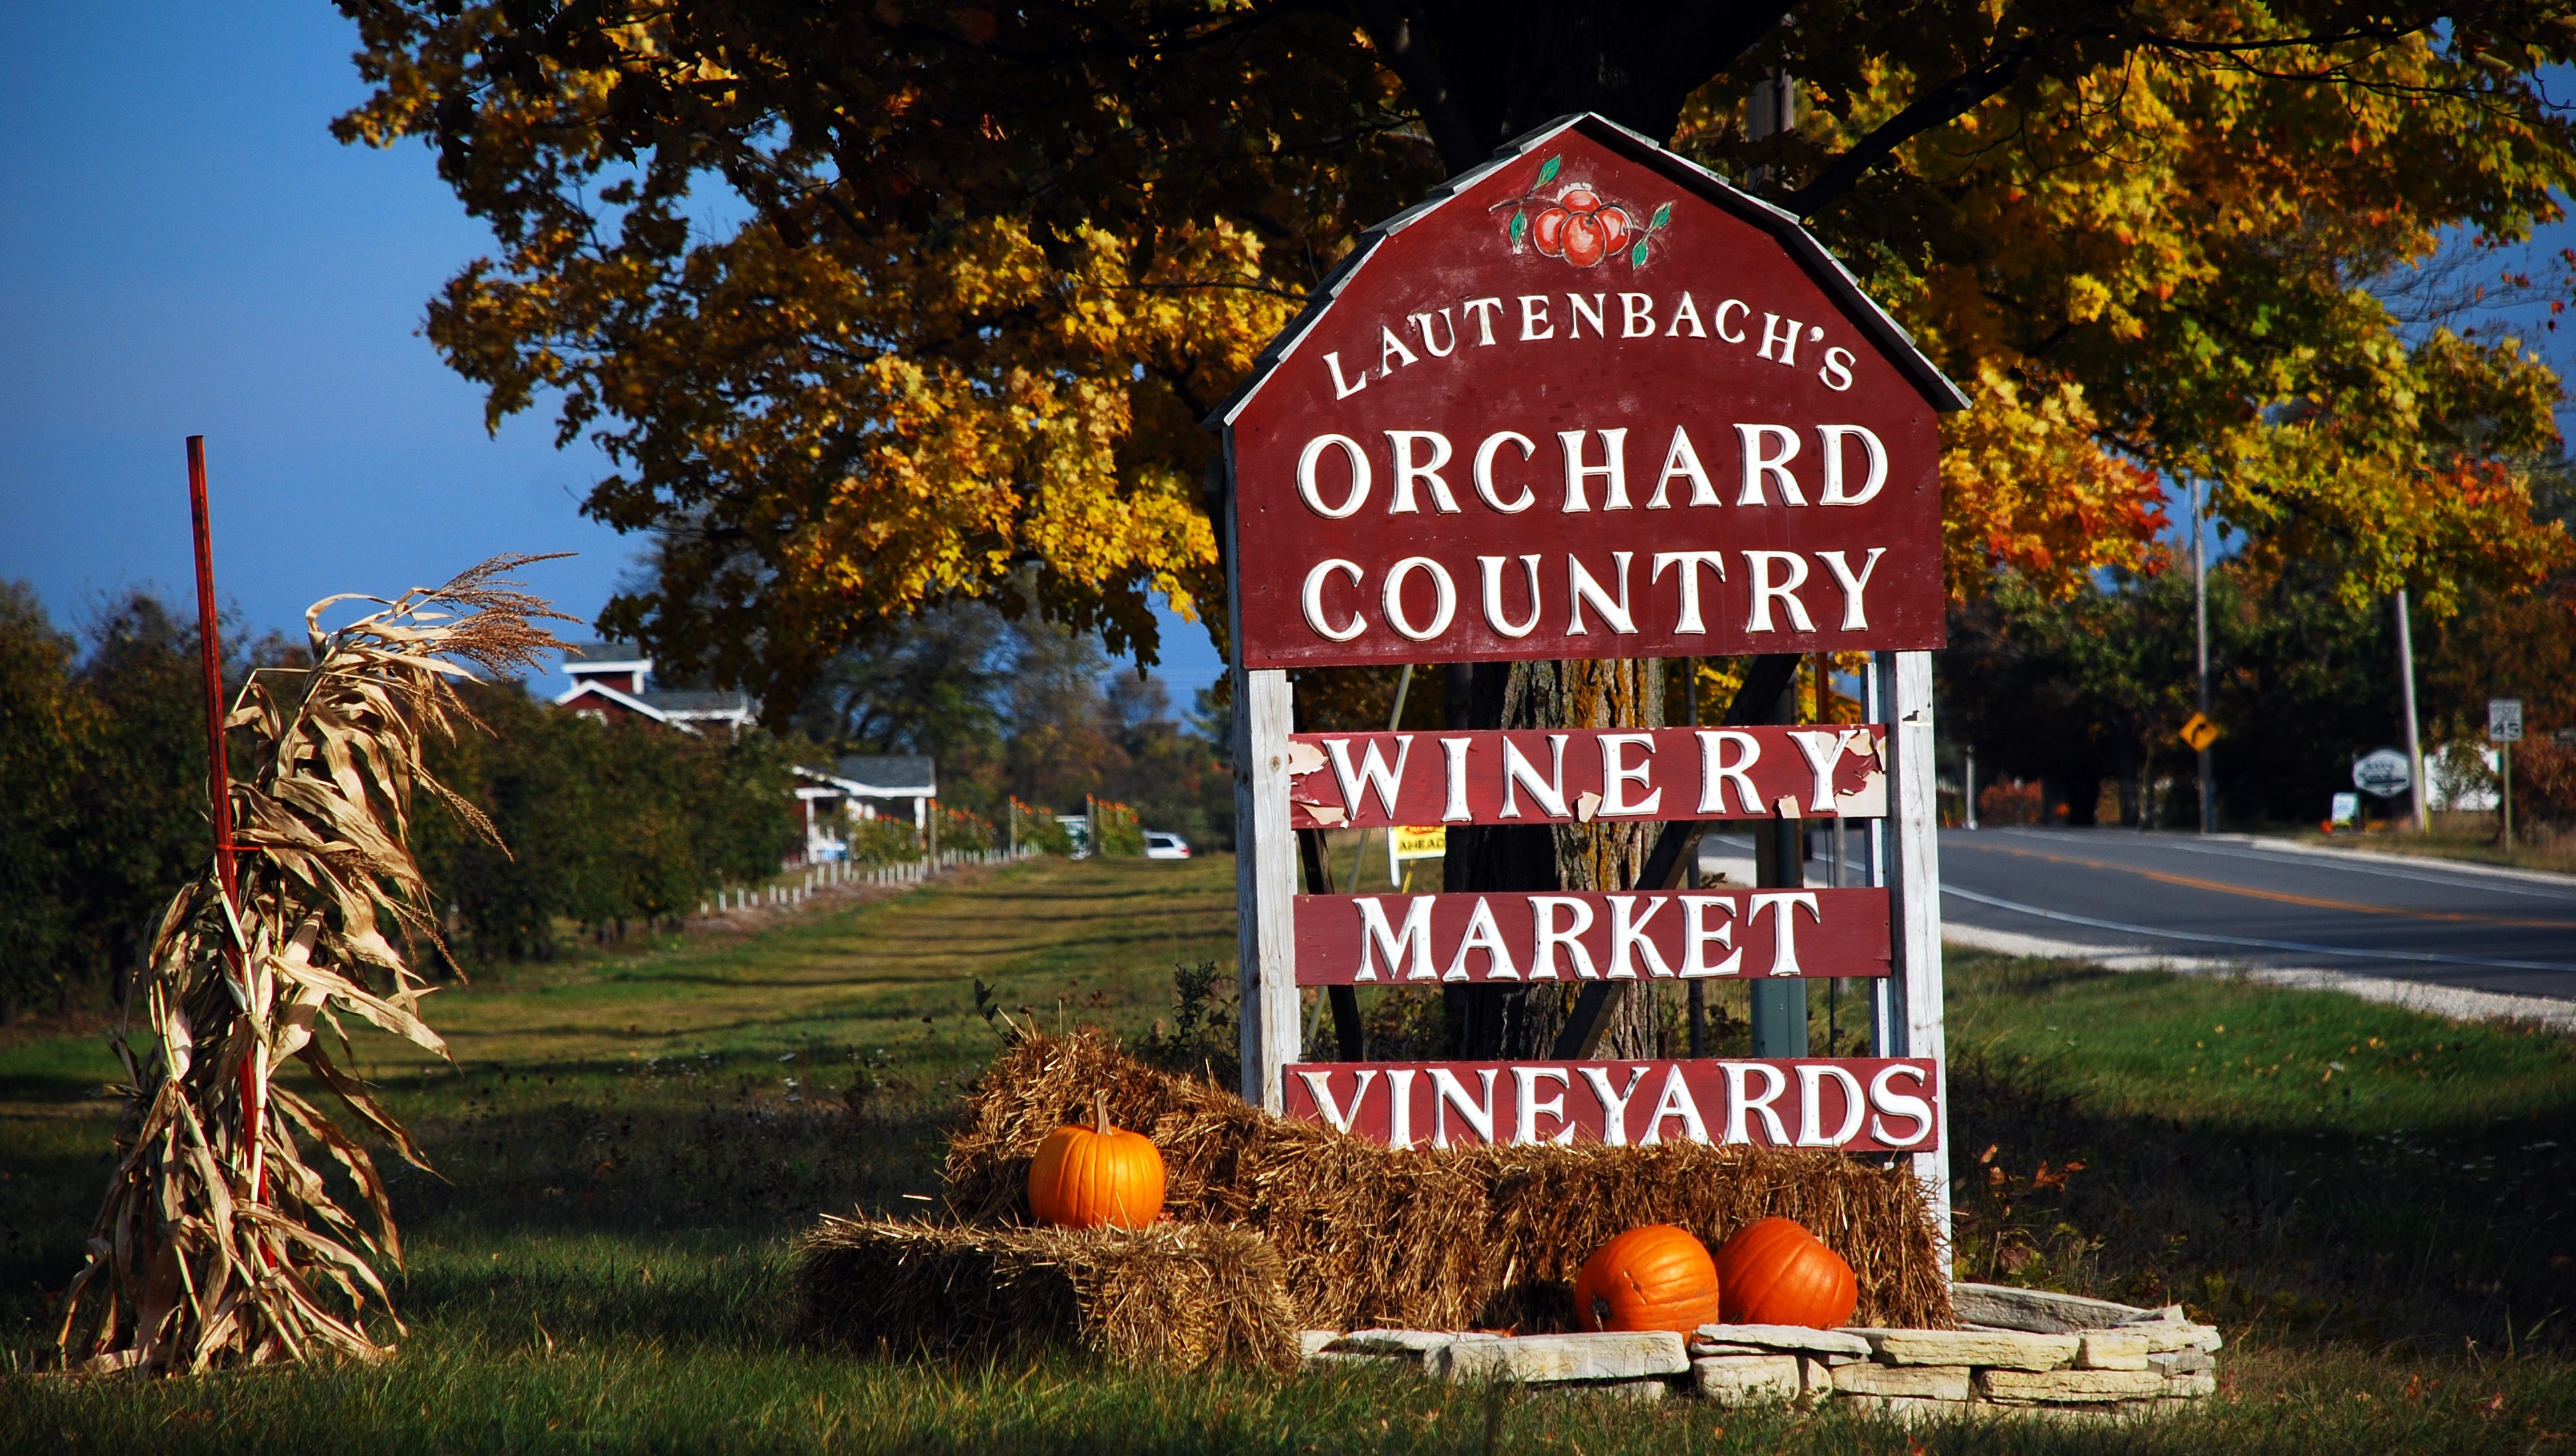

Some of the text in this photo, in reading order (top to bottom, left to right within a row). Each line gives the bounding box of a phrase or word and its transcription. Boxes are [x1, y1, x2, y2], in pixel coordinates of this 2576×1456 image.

[1323, 290, 1856, 401] LAUTENBACH'S
[1297, 423, 1889, 519] ORCHARD
[1301, 547, 1887, 642] COUNTRY
[2492, 721, 2519, 737] 45
[1322, 729, 1856, 822] WINERY
[1399, 838, 1445, 851] AHEAD
[1351, 892, 1821, 982] MARKET
[1297, 1062, 1934, 1151] VINEYARDS
